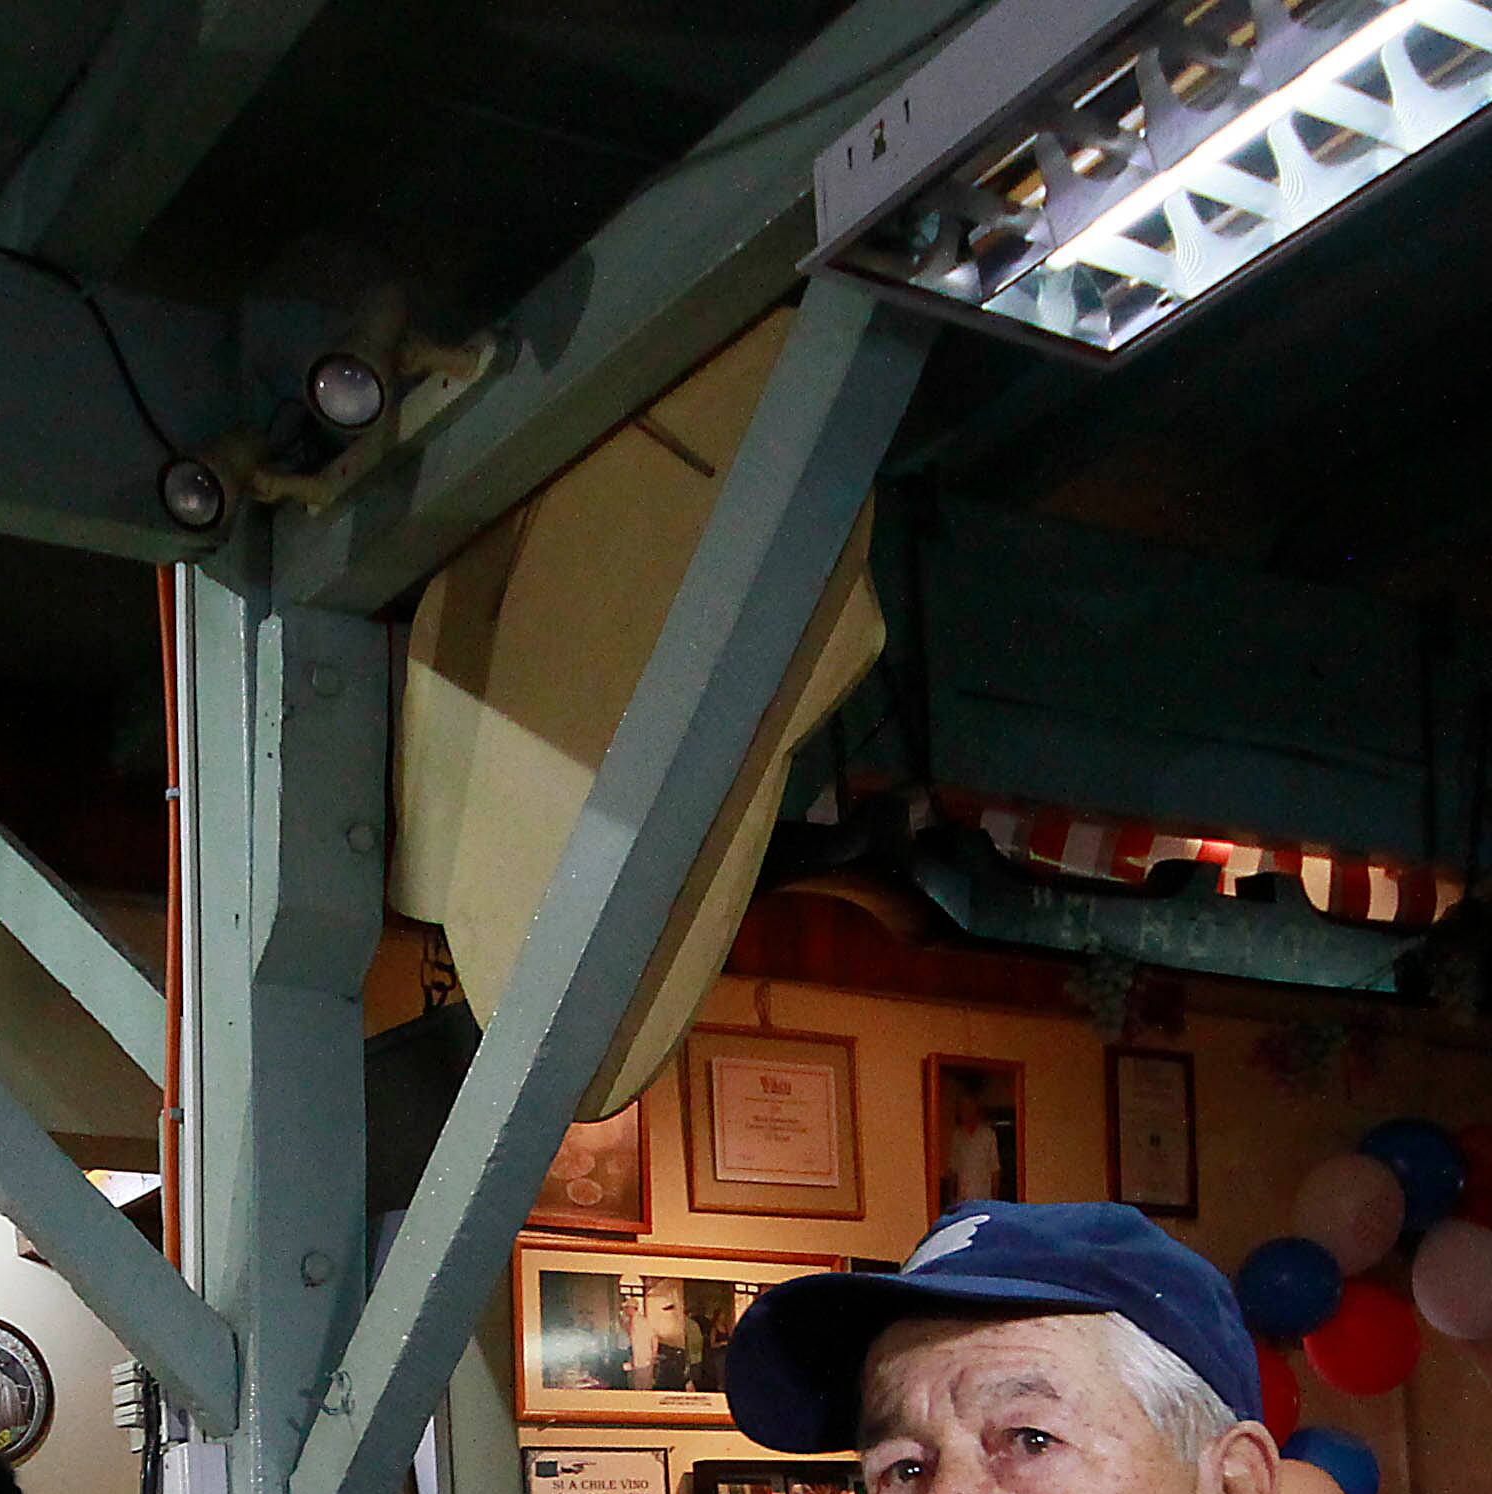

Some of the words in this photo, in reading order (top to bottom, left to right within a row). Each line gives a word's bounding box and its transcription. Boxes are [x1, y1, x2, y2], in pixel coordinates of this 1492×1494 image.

[552, 1480, 565, 1490] SI
[568, 1480, 578, 1490] A
[581, 1480, 617, 1490] CHILE
[620, 1479, 649, 1490] VINO
